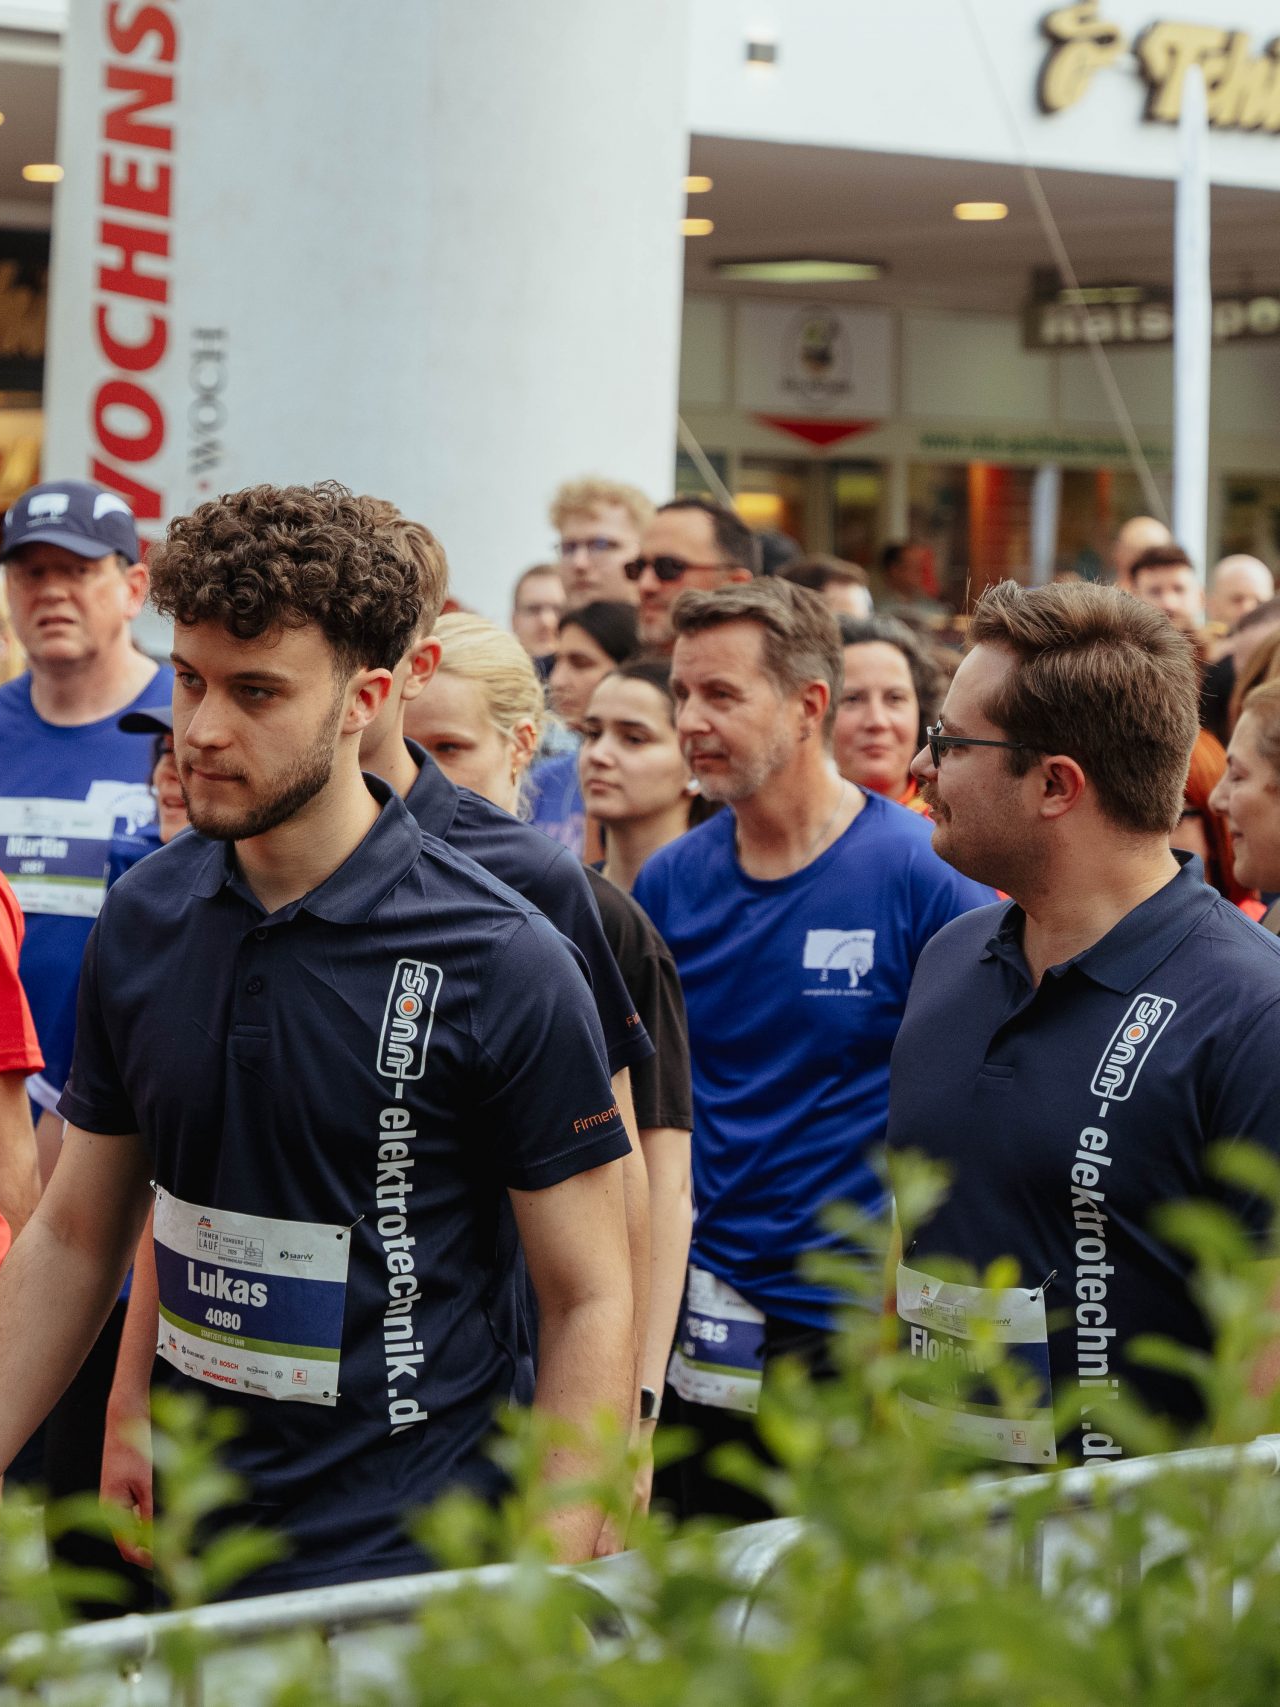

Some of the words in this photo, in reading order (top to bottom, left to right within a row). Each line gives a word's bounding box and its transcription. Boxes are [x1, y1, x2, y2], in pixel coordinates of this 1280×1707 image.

[5, 836, 69, 859] Martin
[199, 1230, 219, 1241] FIRMEN
[199, 1238, 219, 1251] LAUF
[376, 1082, 428, 1437] -elektrotechnik.d
[187, 1261, 268, 1308] Lukas
[205, 1307, 241, 1331] 4080
[219, 1360, 239, 1370] BOSCH
[202, 1369, 238, 1385] WOCHENSPIEGEL
